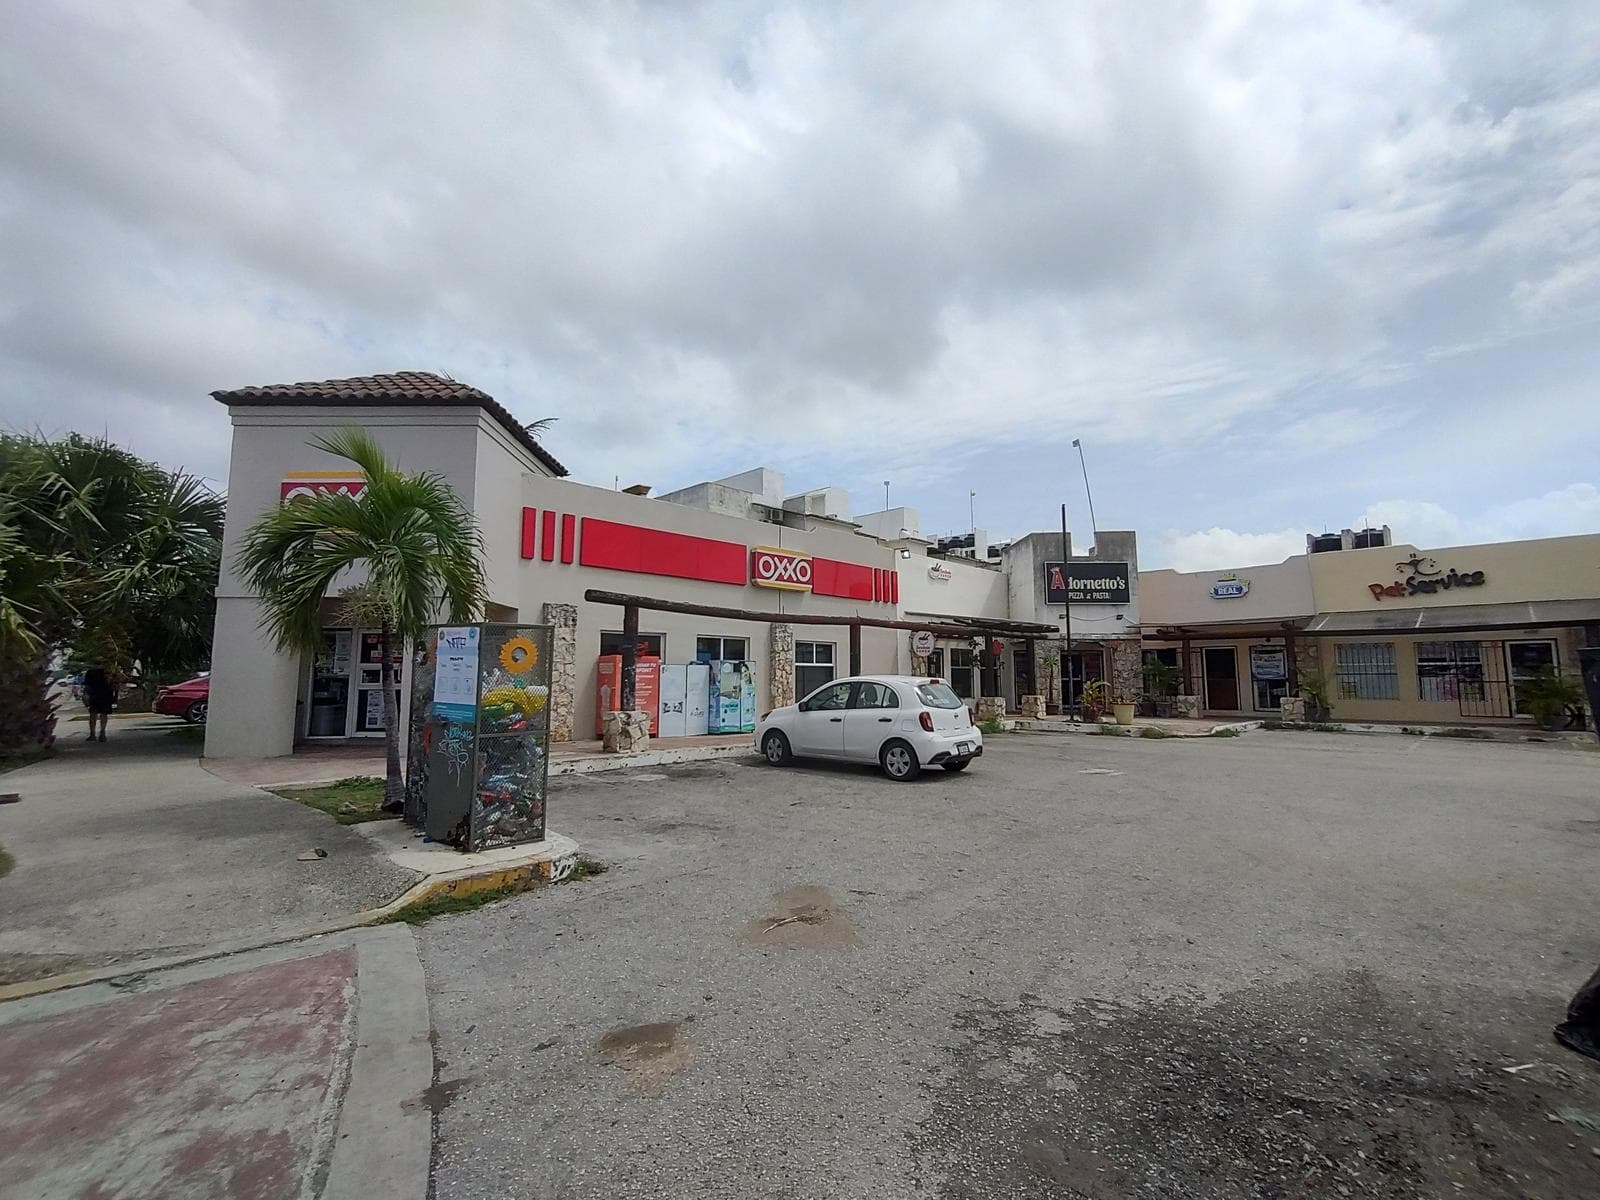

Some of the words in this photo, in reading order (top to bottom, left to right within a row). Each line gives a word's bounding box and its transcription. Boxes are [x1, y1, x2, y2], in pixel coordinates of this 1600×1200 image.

[759, 556, 811, 582] OXXO
[1068, 591, 1084, 600] PIZZA
[1092, 591, 1110, 600] PASTA
